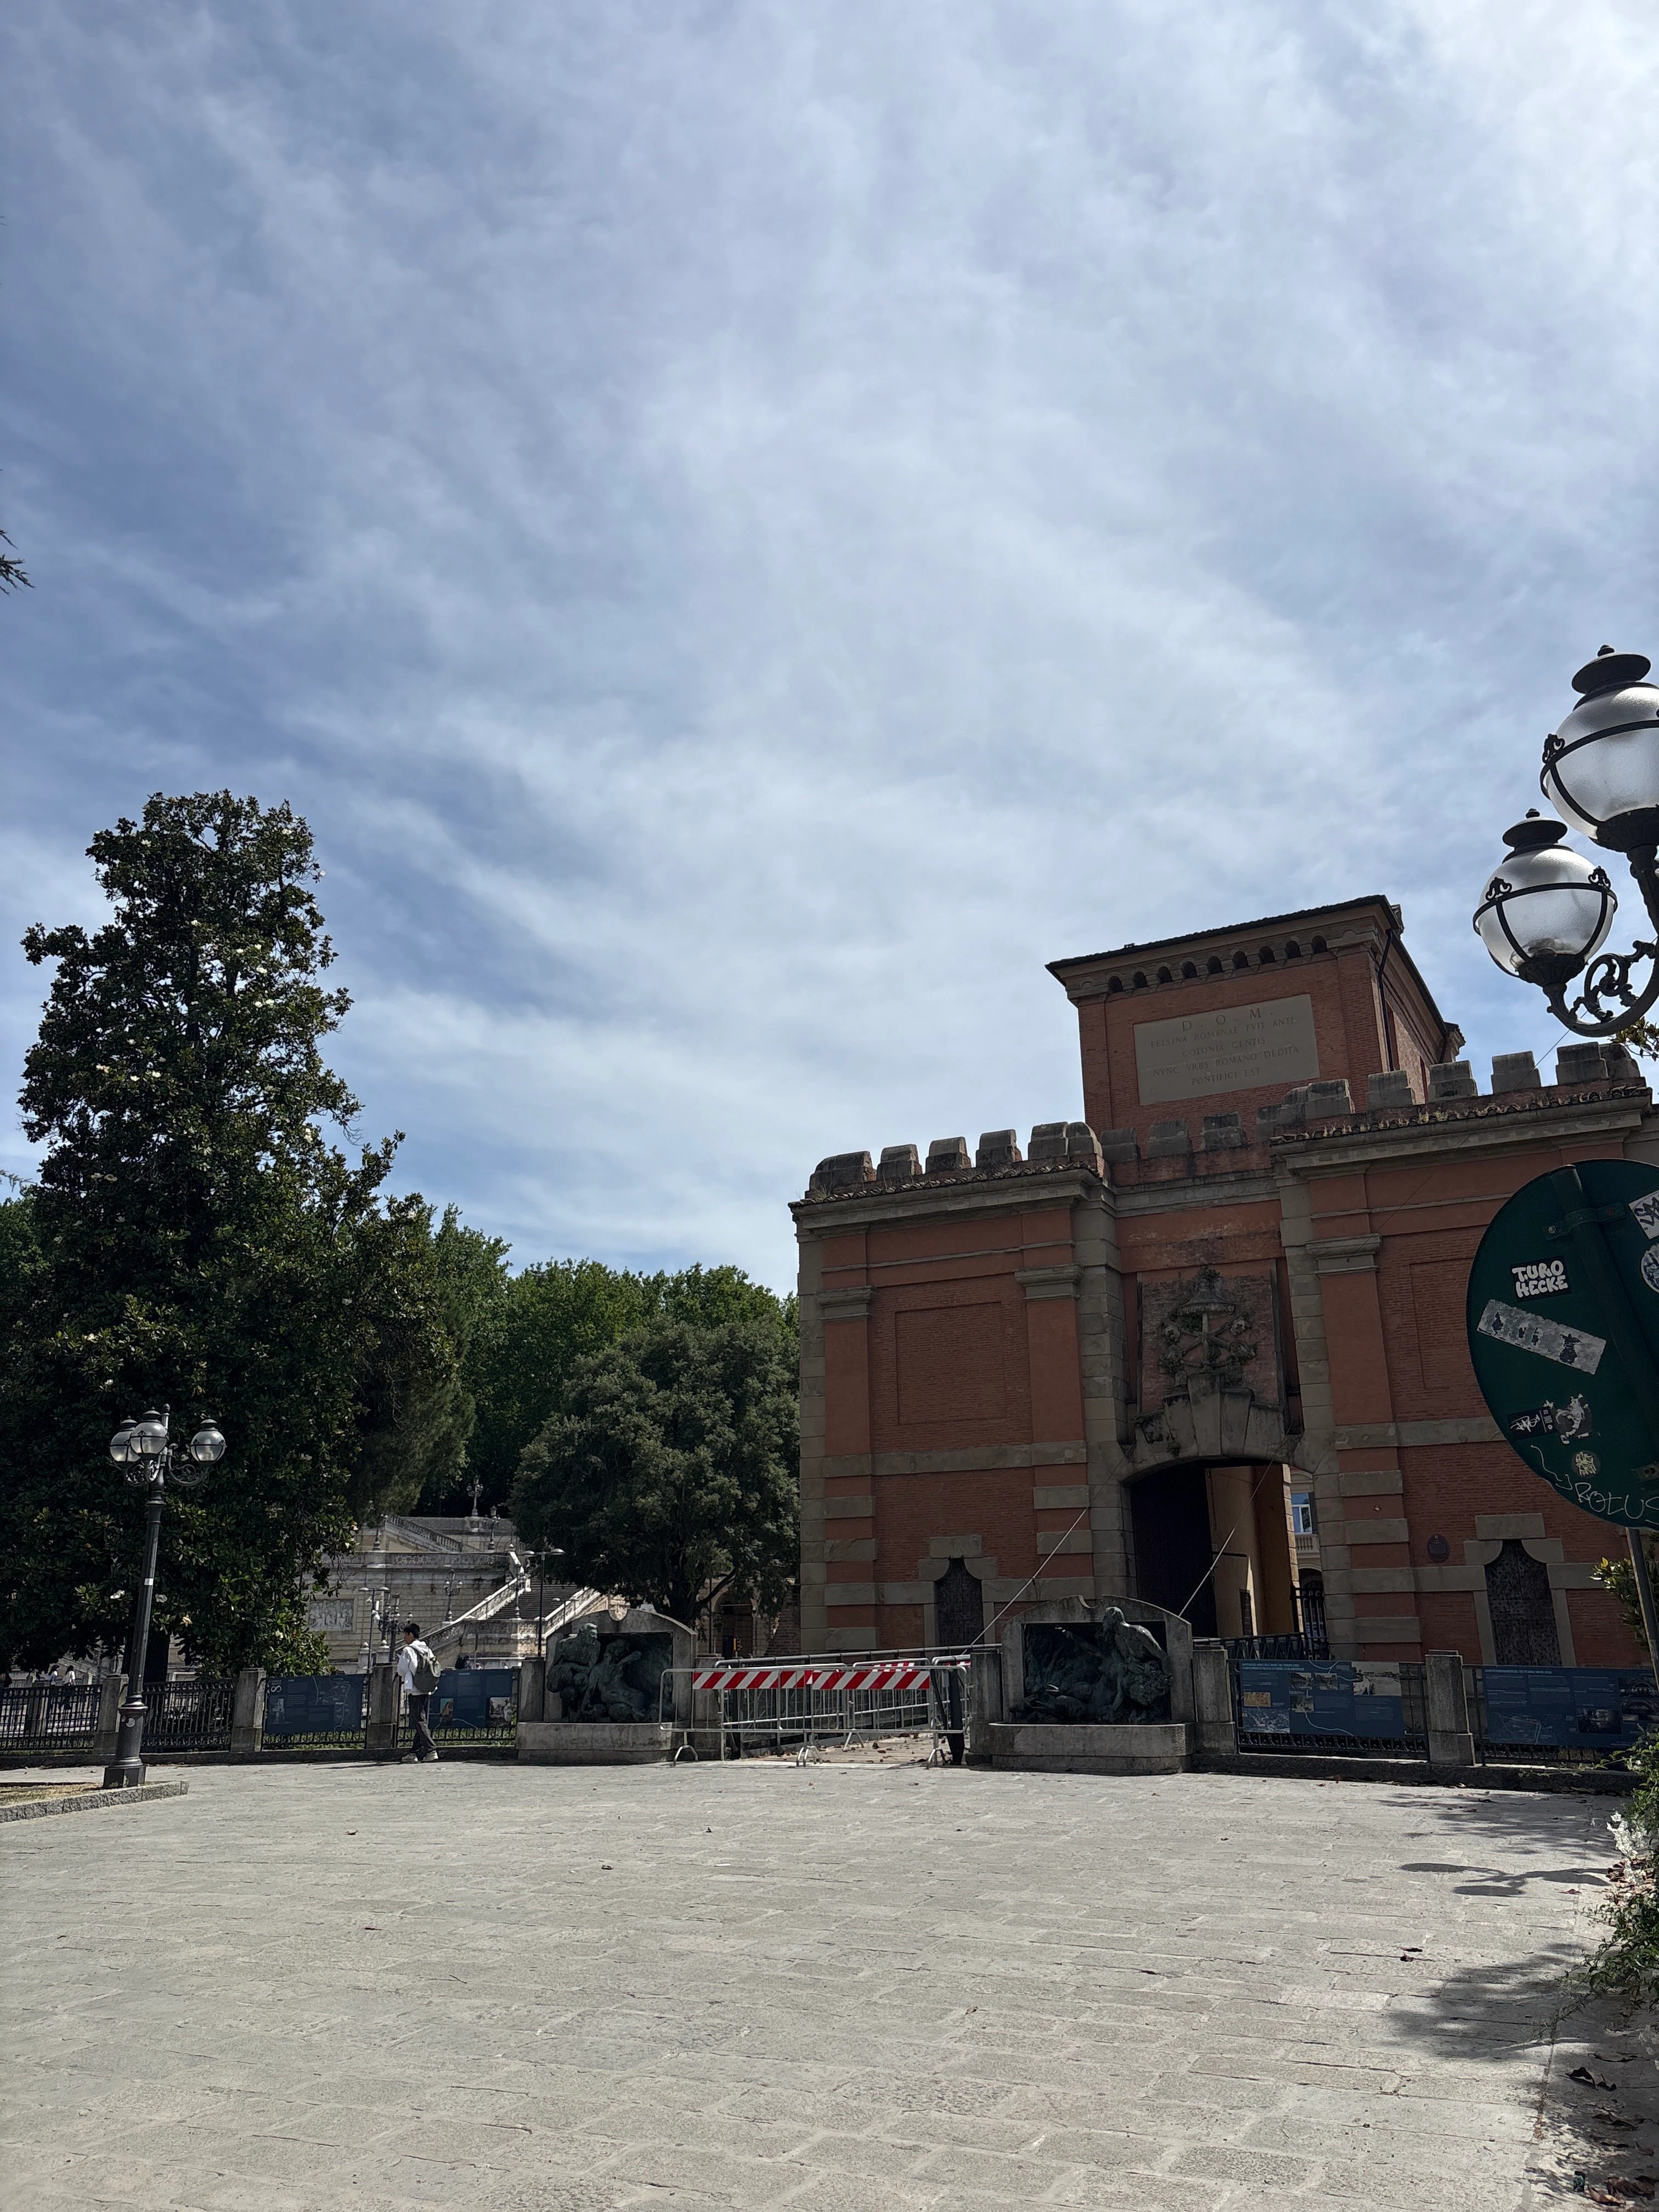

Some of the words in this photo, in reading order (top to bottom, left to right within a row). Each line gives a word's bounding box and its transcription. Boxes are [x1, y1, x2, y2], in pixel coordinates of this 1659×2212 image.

[1150, 1036, 1187, 1048] FELSINA
[1194, 1026, 1238, 1041] ROMANAE
[1246, 1022, 1265, 1031] FVIT
[1273, 1016, 1296, 1028] ANTE
[1153, 1066, 1179, 1076] NVNC
[1186, 1061, 1209, 1071] VRBS
[1216, 1053, 1257, 1066] ROMANO
[1264, 1046, 1299, 1059] DEDITA
[1183, 1045, 1224, 1057] COLONIA
[1192, 1071, 1237, 1085] PONTIFICI
[1244, 1067, 1260, 1076] EST
[1515, 1275, 1568, 1297] HECKE
